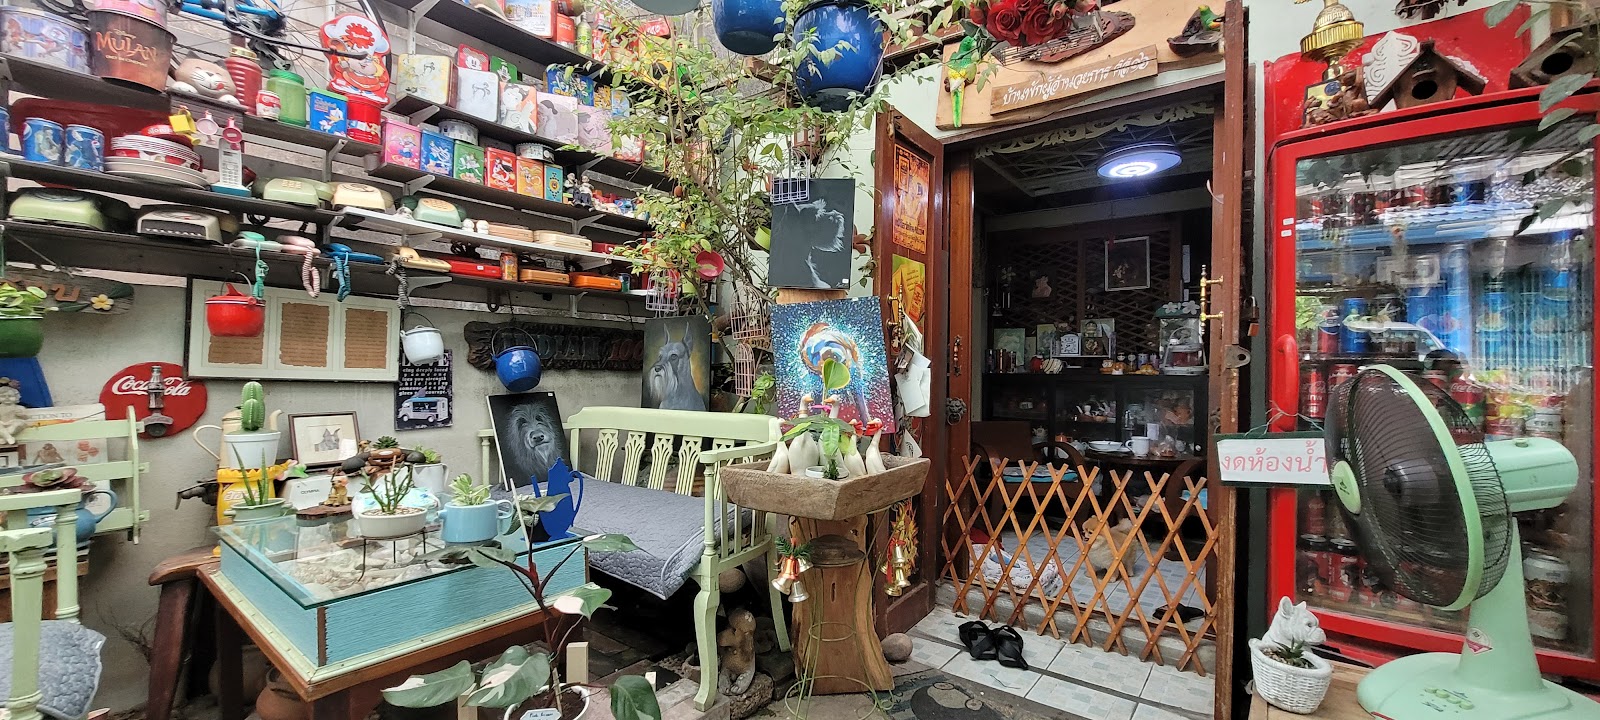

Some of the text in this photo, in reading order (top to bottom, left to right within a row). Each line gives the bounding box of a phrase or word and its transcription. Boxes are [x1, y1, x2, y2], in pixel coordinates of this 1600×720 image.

[96, 31, 157, 61] MULAN
[402, 353, 449, 367] LE
[1221, 440, 1327, 473] งดห้องน้ำ
